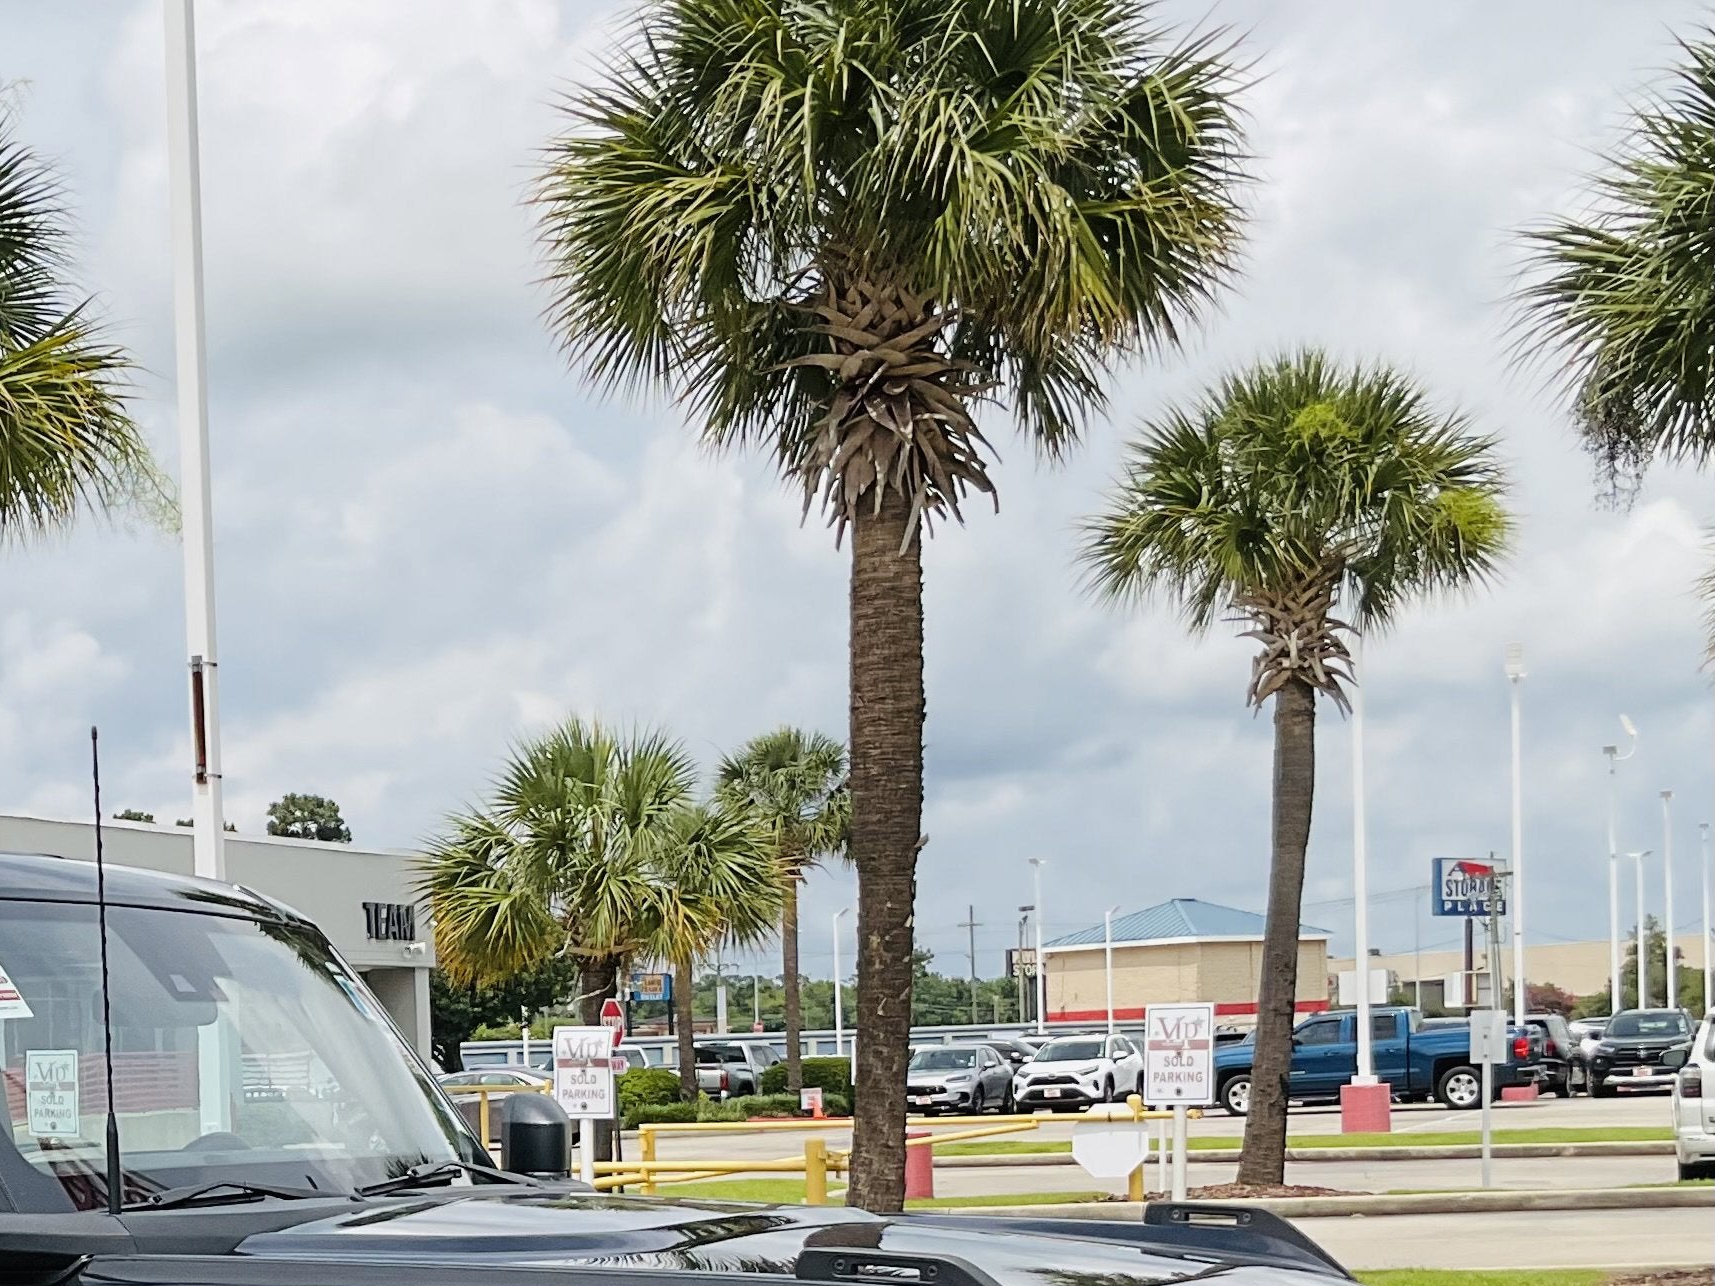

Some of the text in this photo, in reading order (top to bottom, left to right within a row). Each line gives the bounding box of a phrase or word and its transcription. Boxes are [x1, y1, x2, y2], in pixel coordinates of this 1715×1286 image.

[1445, 879, 1503, 898] STORAE
[1444, 901, 1504, 911] PLACE
[362, 901, 415, 940] TEAM
[1164, 1055, 1195, 1067] SOLD
[571, 1074, 597, 1085] SOLD
[1153, 1071, 1203, 1083] PARKING
[41, 1095, 64, 1105] SOLD
[562, 1088, 605, 1100] PARKING
[34, 1108, 72, 1119] PARKING
